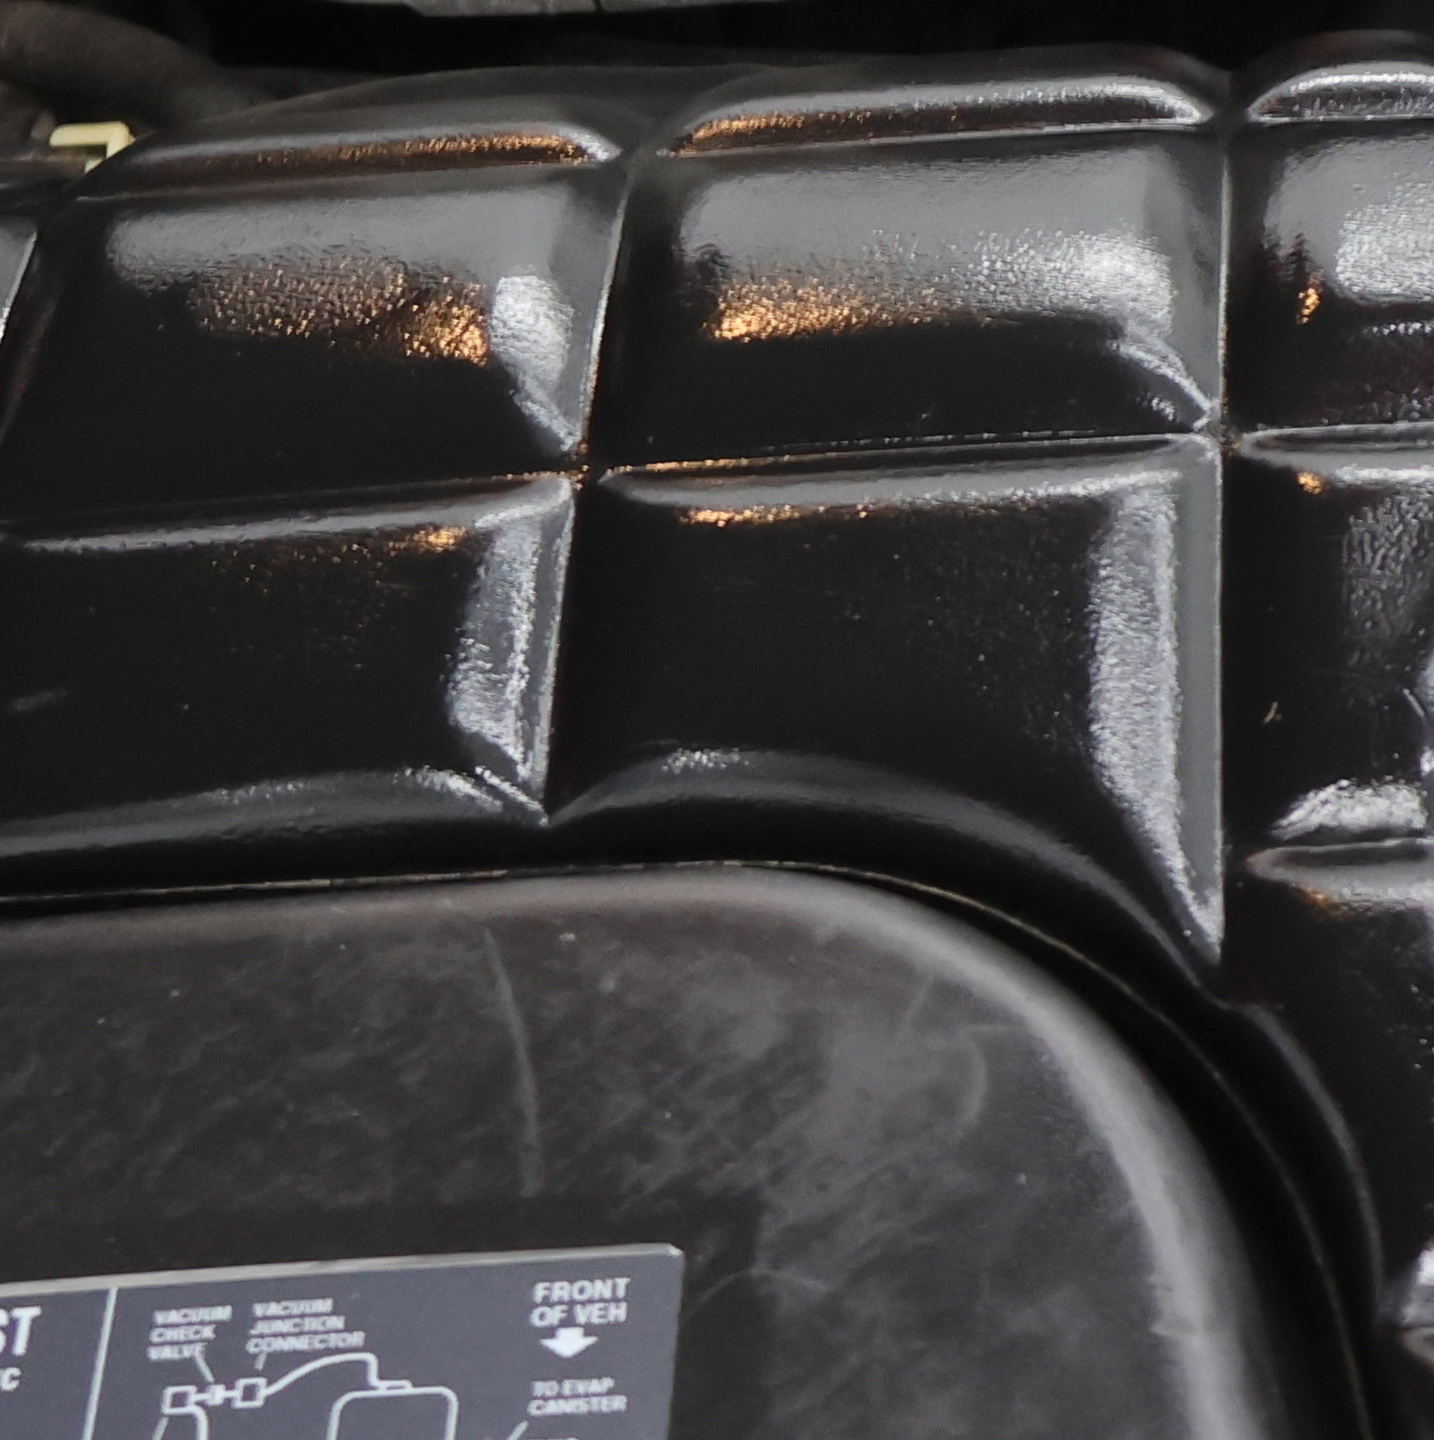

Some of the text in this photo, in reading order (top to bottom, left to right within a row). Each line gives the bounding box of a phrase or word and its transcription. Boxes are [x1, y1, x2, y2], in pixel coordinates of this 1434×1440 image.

[532, 1277, 631, 1304] FRONT
[248, 1315, 346, 1336] JUNCTION
[529, 1301, 629, 1328] OF VEH
[148, 1324, 216, 1344] CHECK
[245, 1331, 366, 1355] CONNECTOR
[146, 1342, 208, 1361] VALVE
[531, 1380, 560, 1398] TO
[527, 1394, 628, 1417] CANISTER
